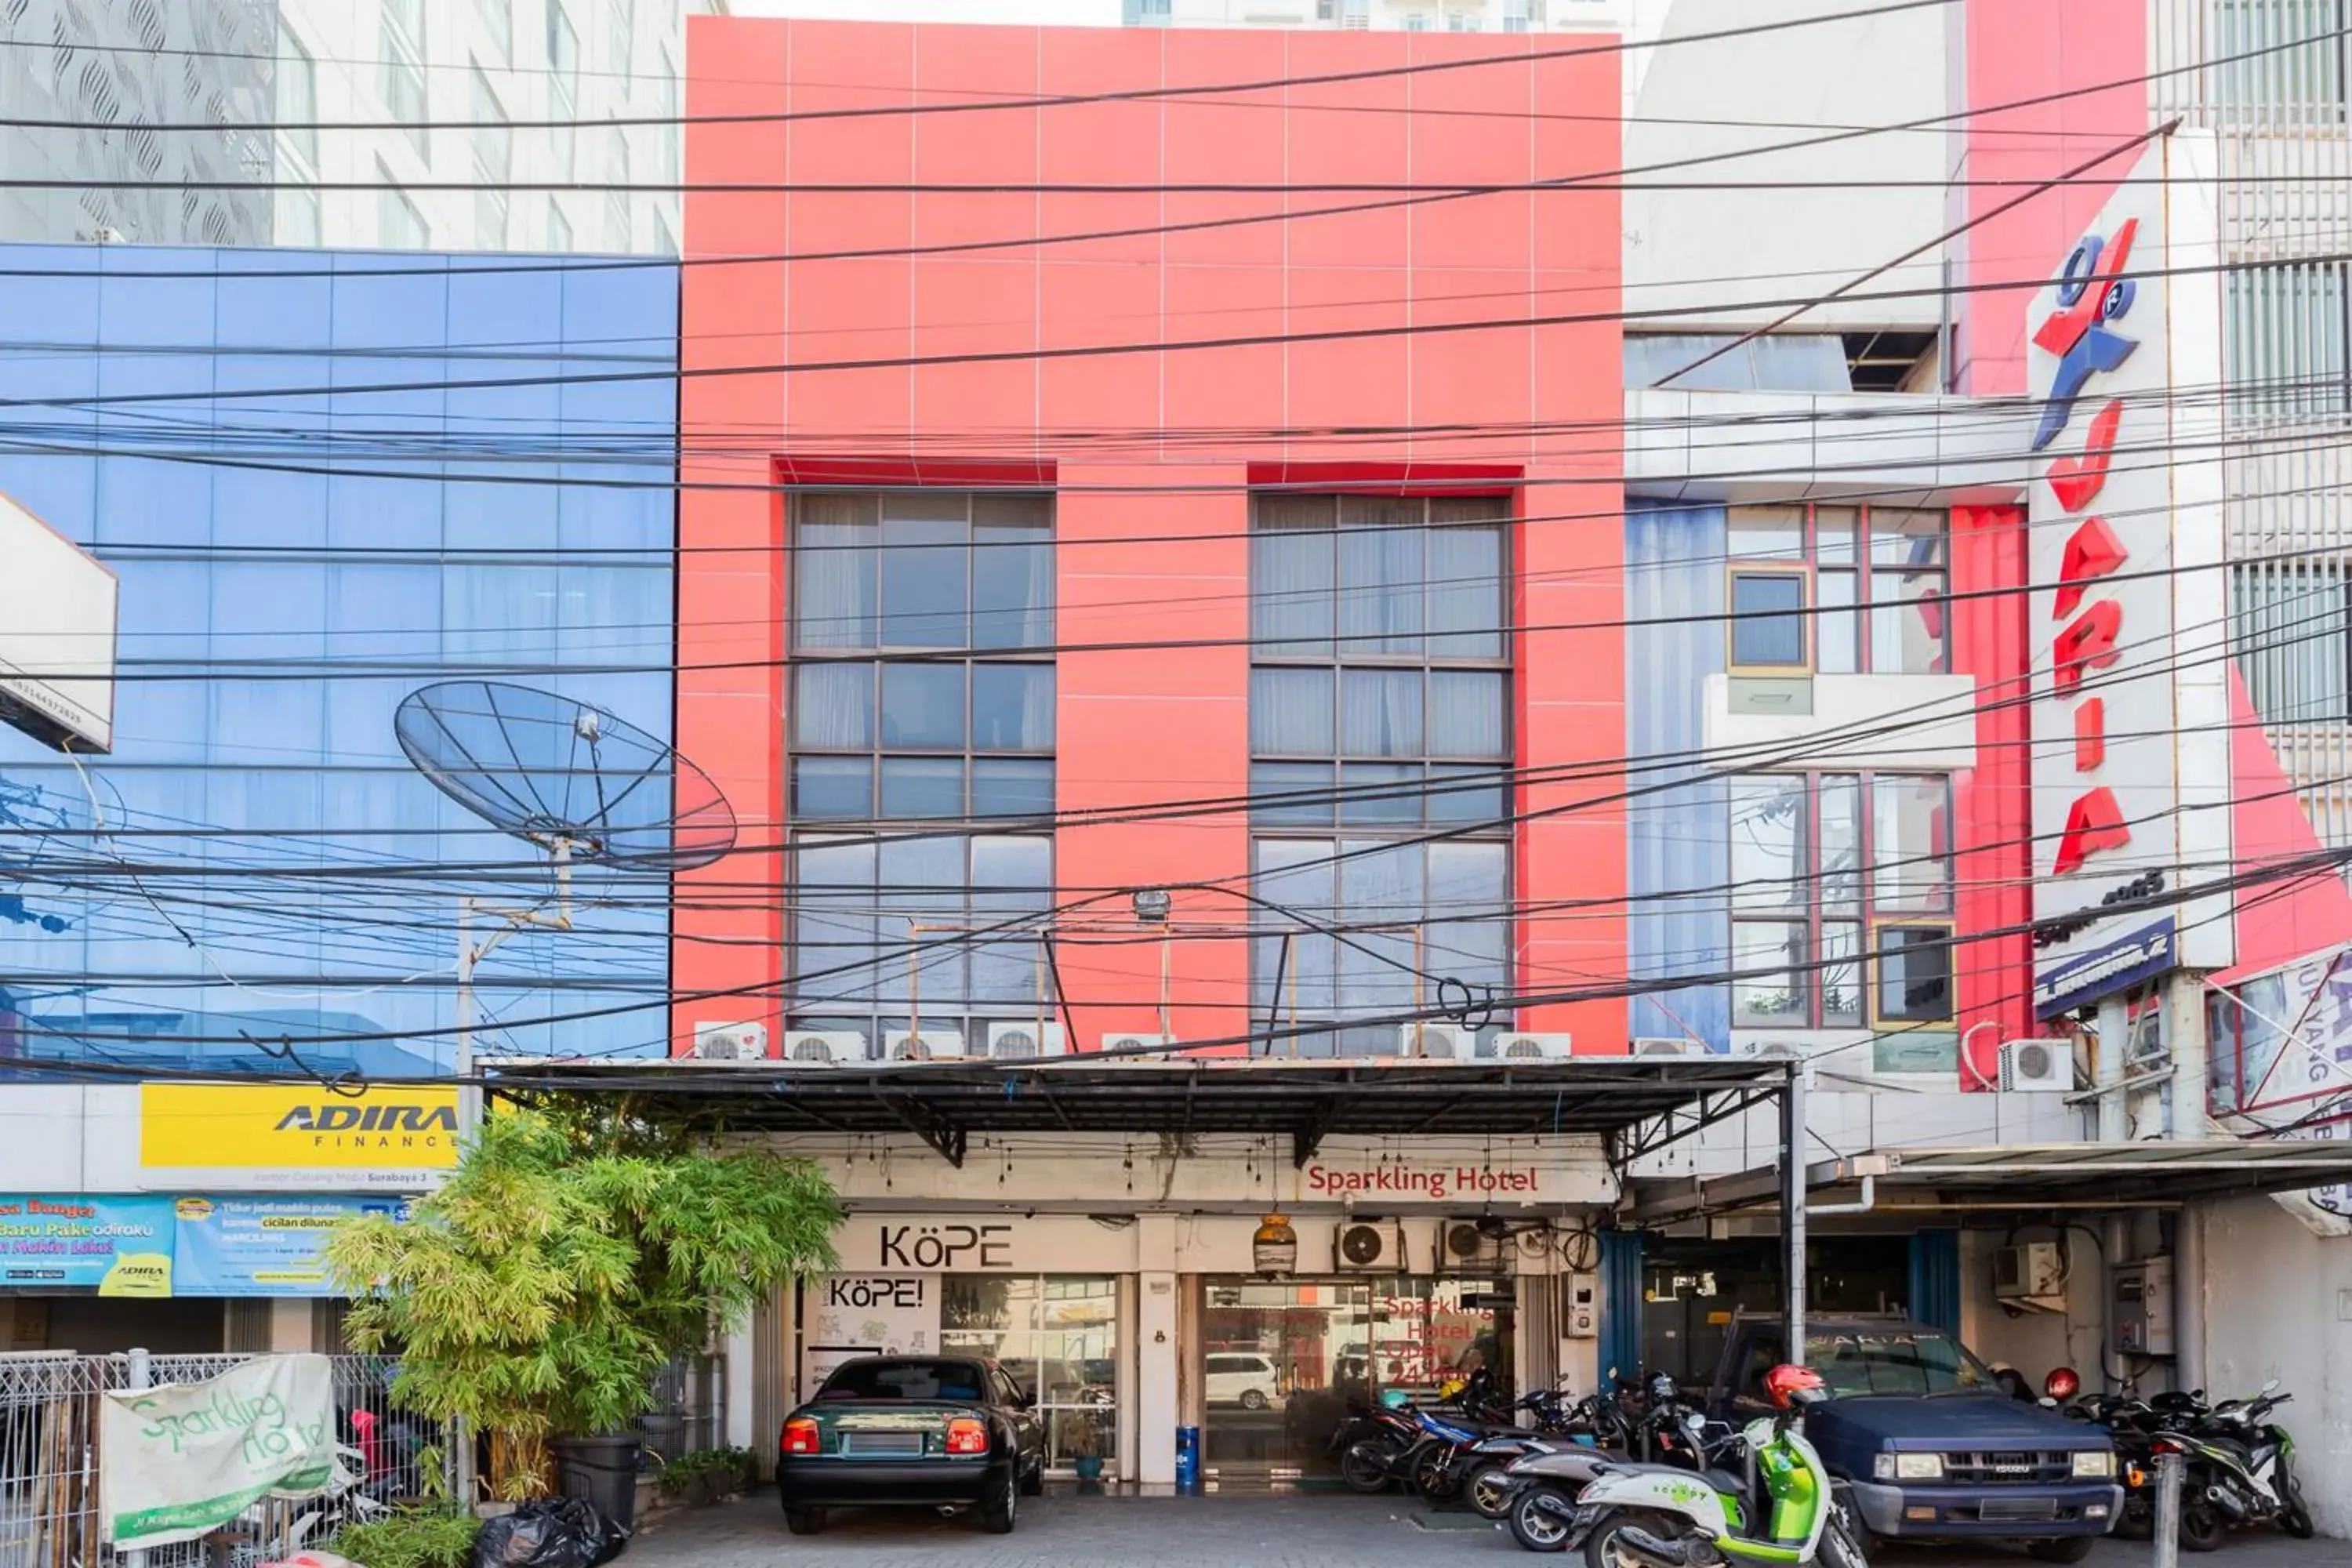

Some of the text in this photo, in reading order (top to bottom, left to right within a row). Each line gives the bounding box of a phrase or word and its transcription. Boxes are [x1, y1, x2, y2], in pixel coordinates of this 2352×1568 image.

[2303, 1008, 2329, 1083] YANG
[273, 1105, 459, 1131] ADIRA
[368, 1173, 416, 1183] Surabaya
[1308, 1166, 1538, 1197] Sparkling Hotel
[28, 1200, 95, 1218] Banget
[263, 1218, 298, 1228] cicilan
[1408, 1320, 1472, 1340] Hotel
[129, 1389, 285, 1452] Sparkling
